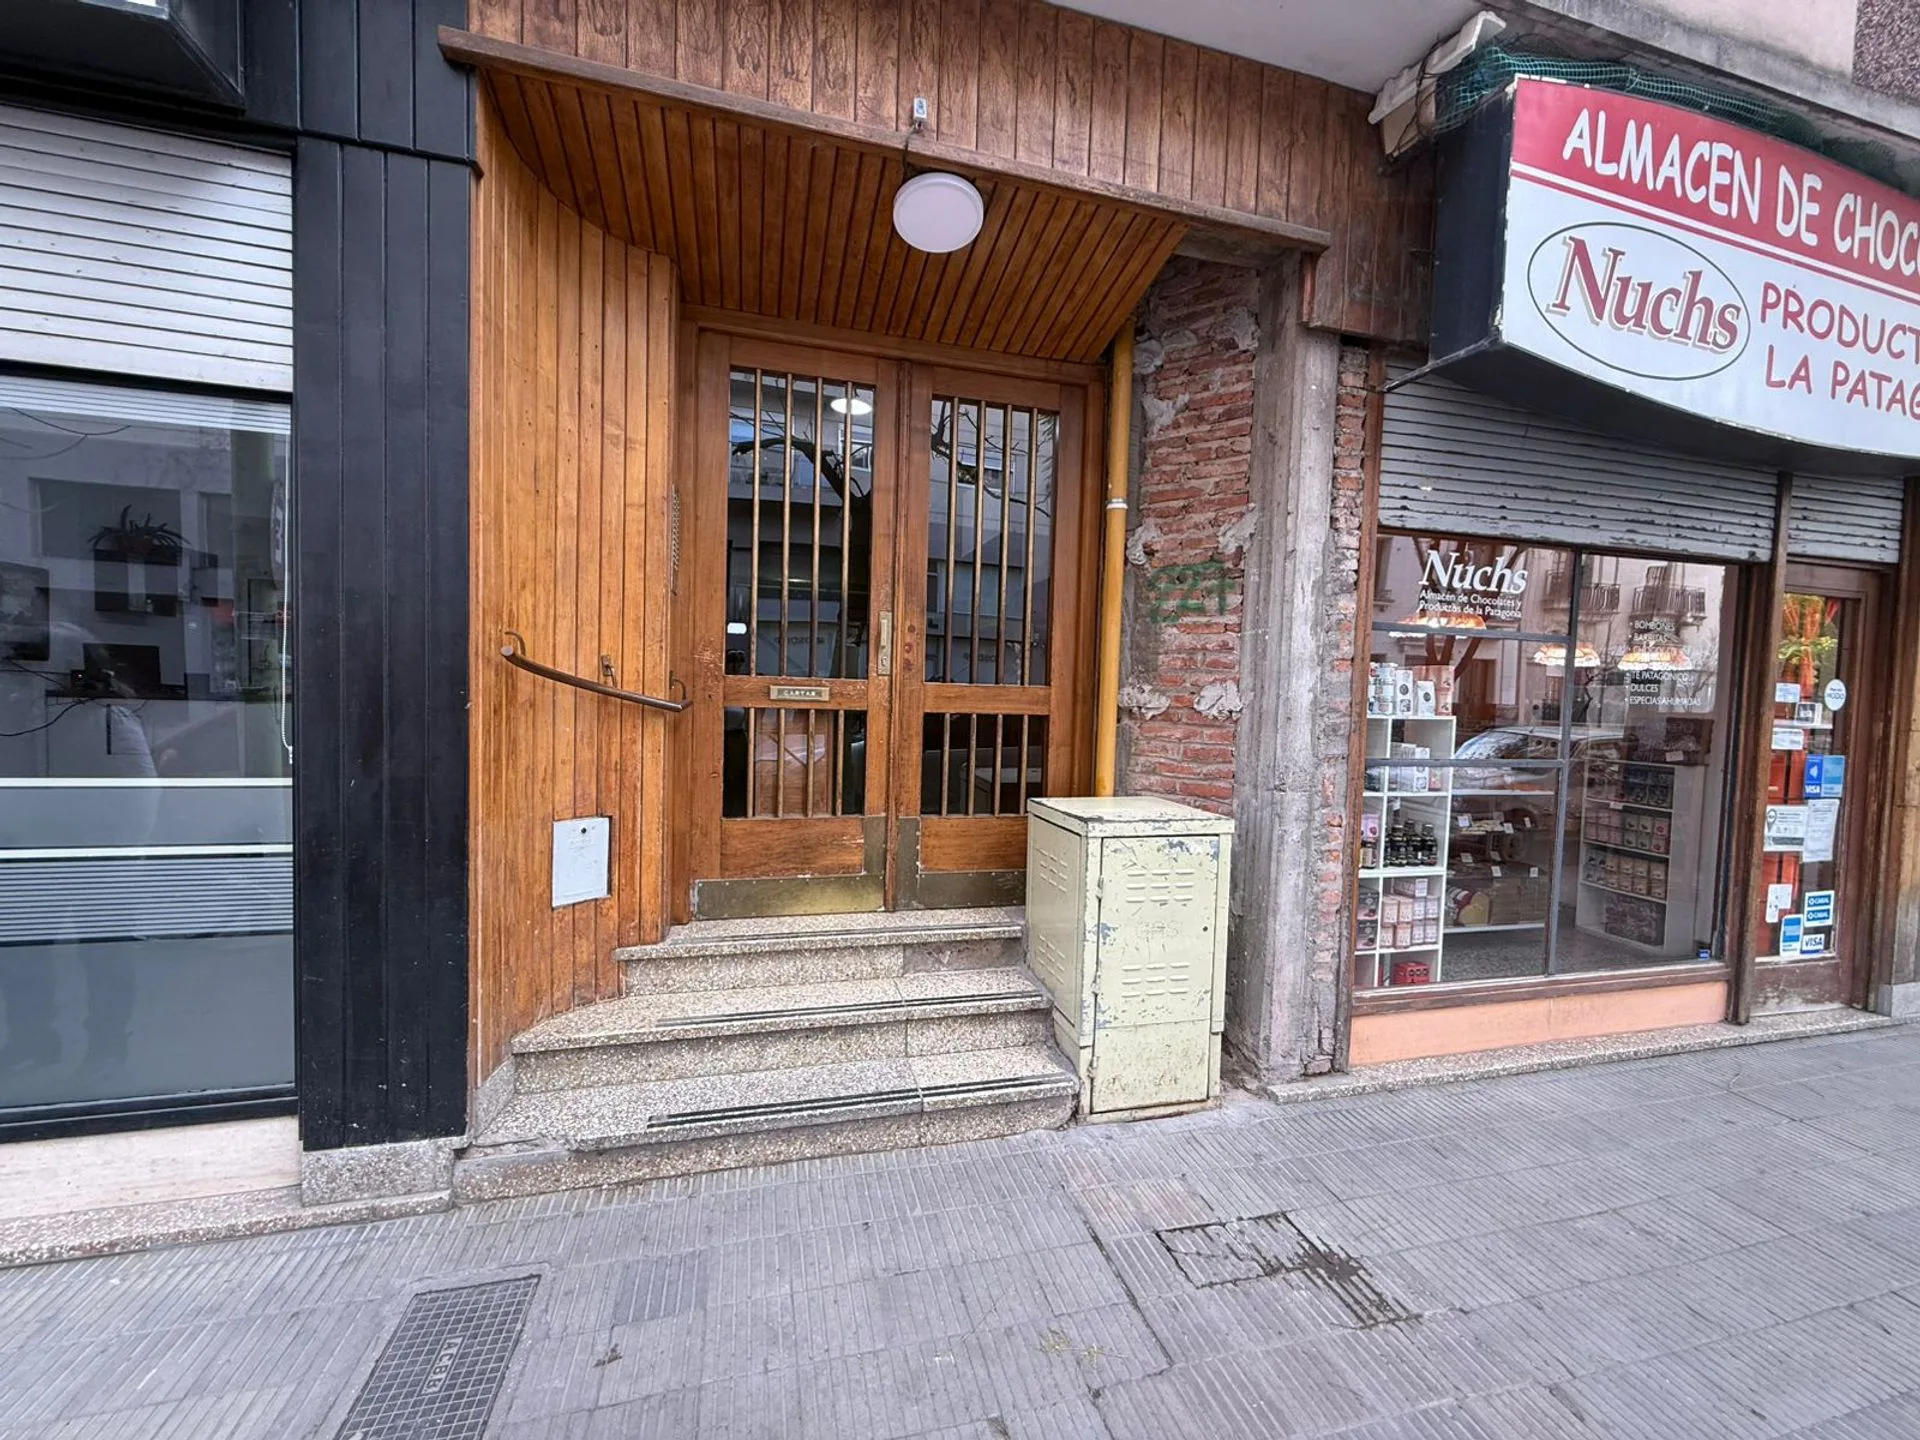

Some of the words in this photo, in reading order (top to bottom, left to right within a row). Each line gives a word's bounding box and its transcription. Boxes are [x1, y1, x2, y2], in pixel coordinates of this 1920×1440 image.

[1562, 107, 1762, 224] ALMACEN
[1775, 164, 1823, 247] DE
[1833, 192, 1919, 277] CHOC
[1547, 235, 1742, 353] Nuchs
[1766, 344, 1812, 394] LA
[1418, 549, 1529, 594] Nuchs
[1458, 593, 1468, 603] de
[1463, 604, 1474, 613] de
[1630, 684, 1659, 693] DULCES
[1804, 936, 1823, 947] VISA
